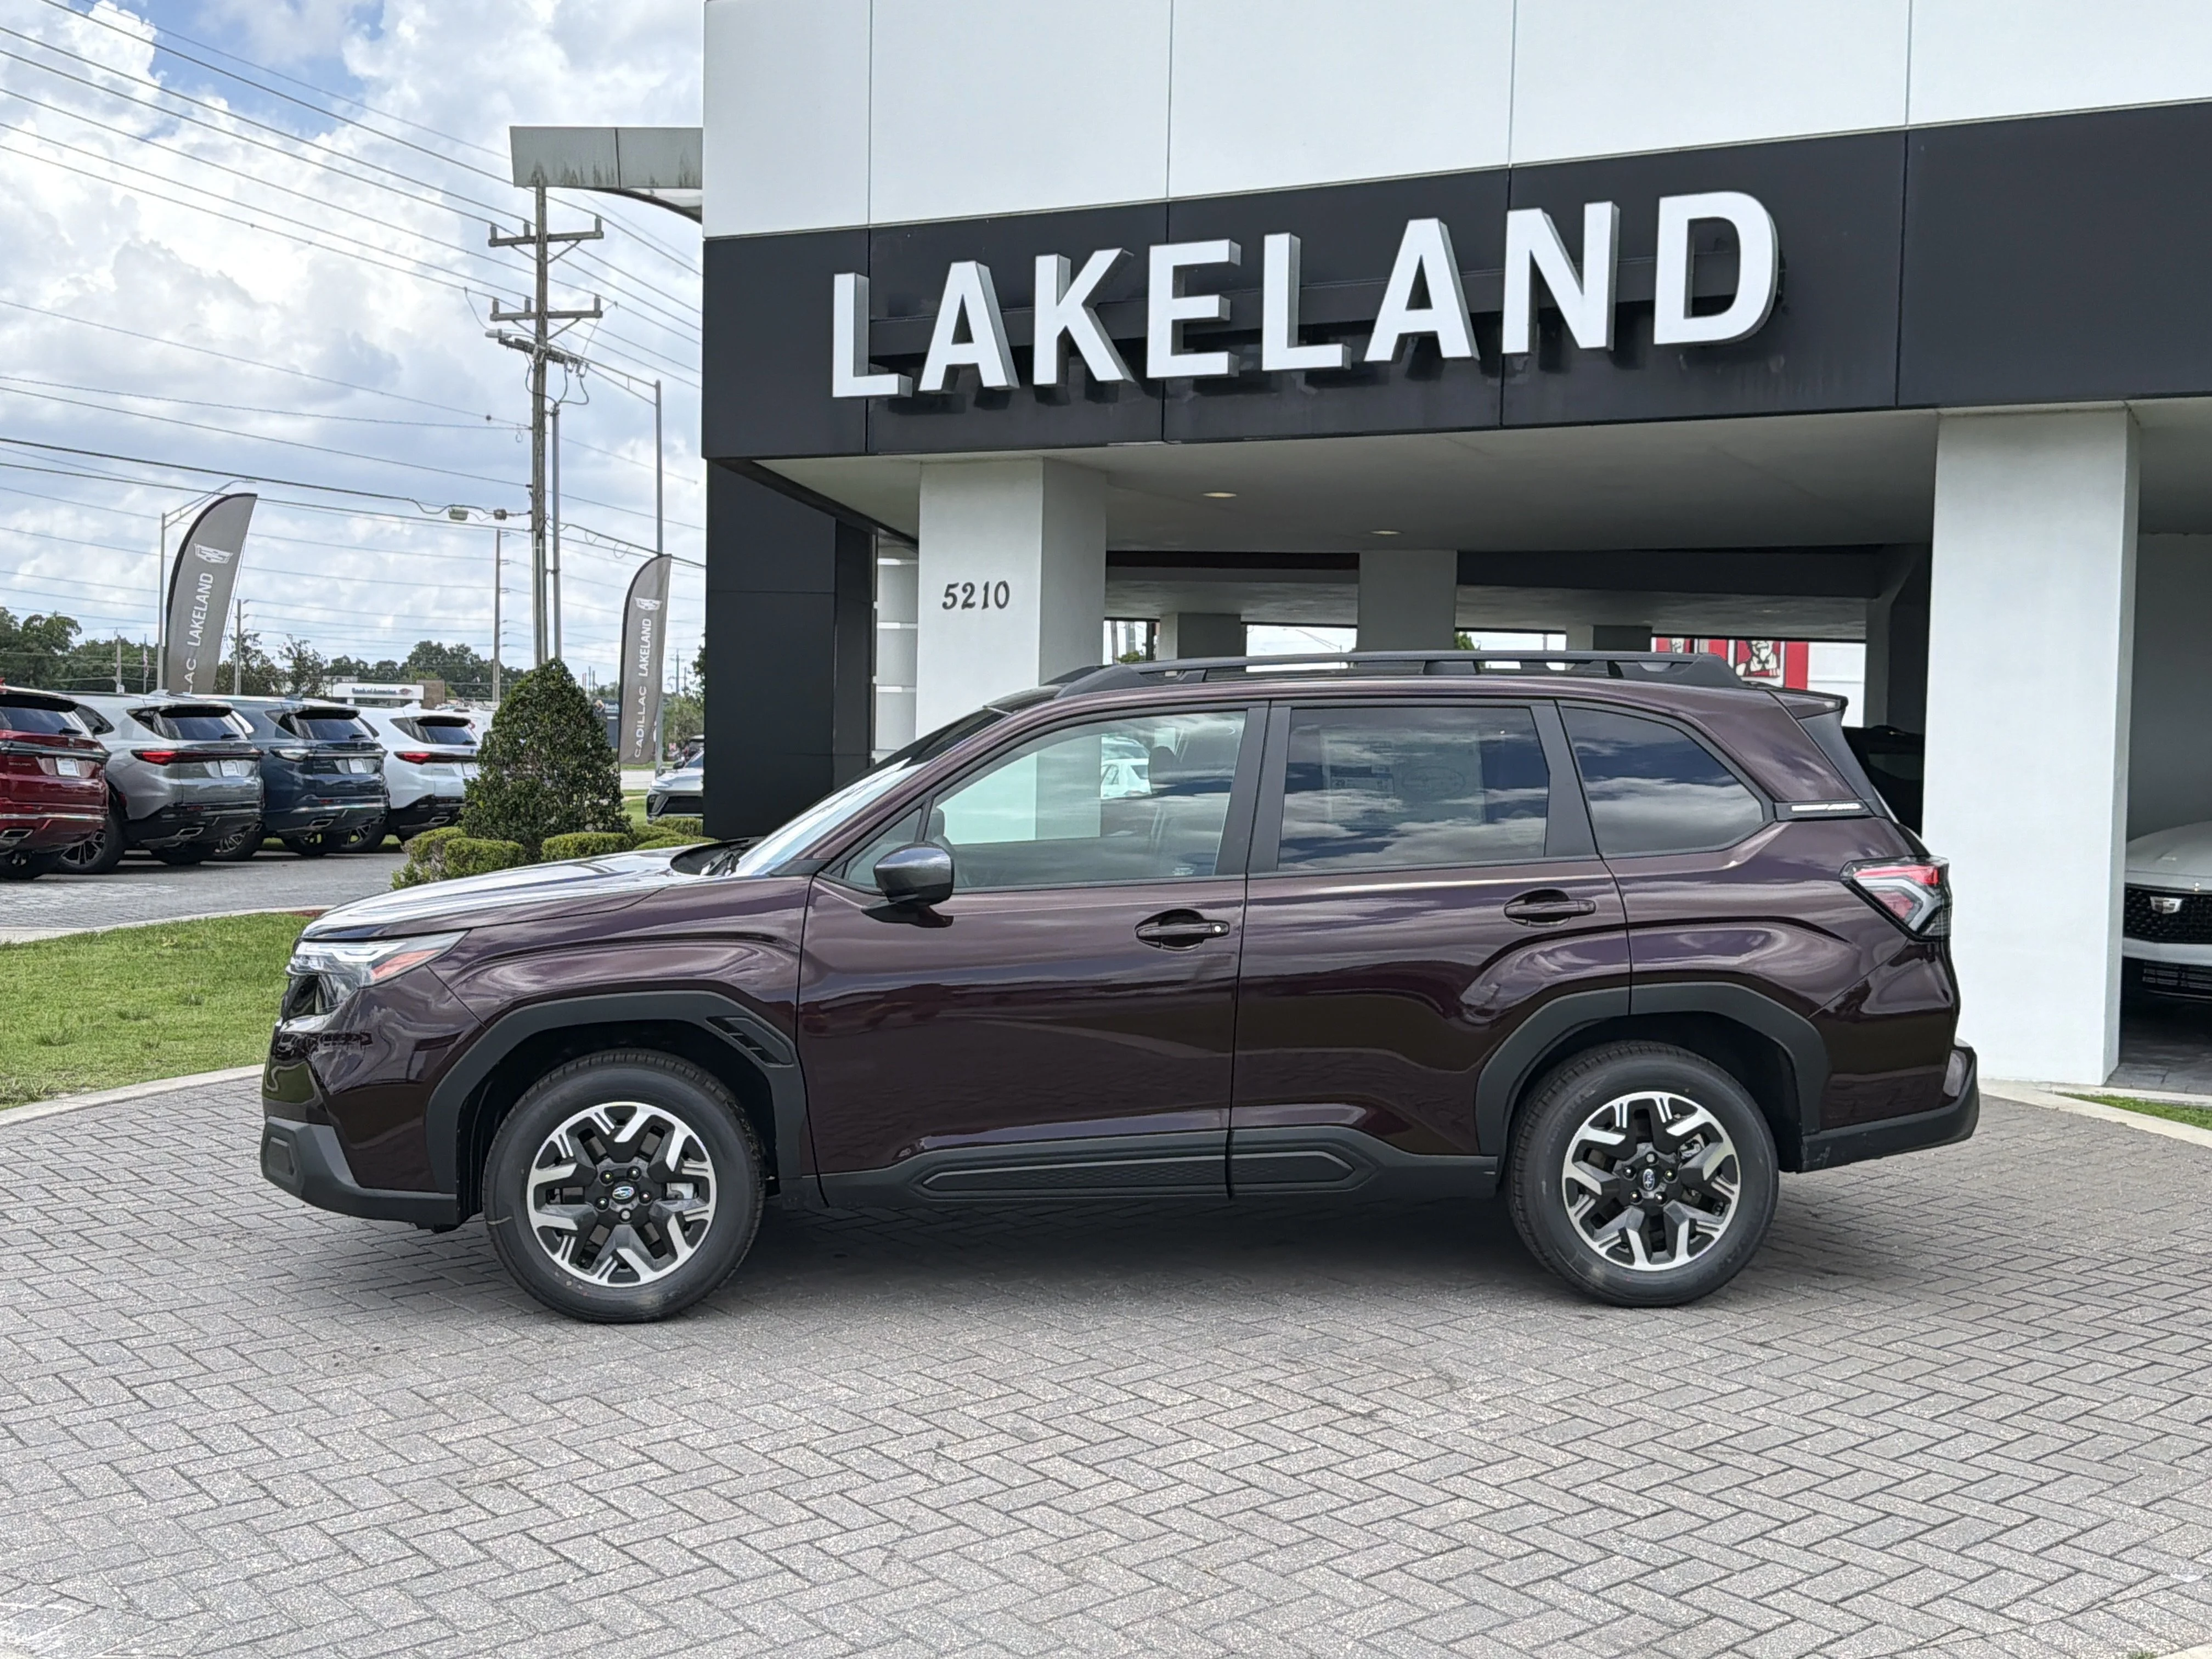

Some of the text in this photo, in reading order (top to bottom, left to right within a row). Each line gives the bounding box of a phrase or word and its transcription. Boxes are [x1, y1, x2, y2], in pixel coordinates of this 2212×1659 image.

[832, 191, 1779, 398] LAKELAND
[187, 573, 213, 646] LAKELAND
[942, 580, 1010, 610] 5210
[634, 618, 652, 758] CADILLAC LAKELAND
